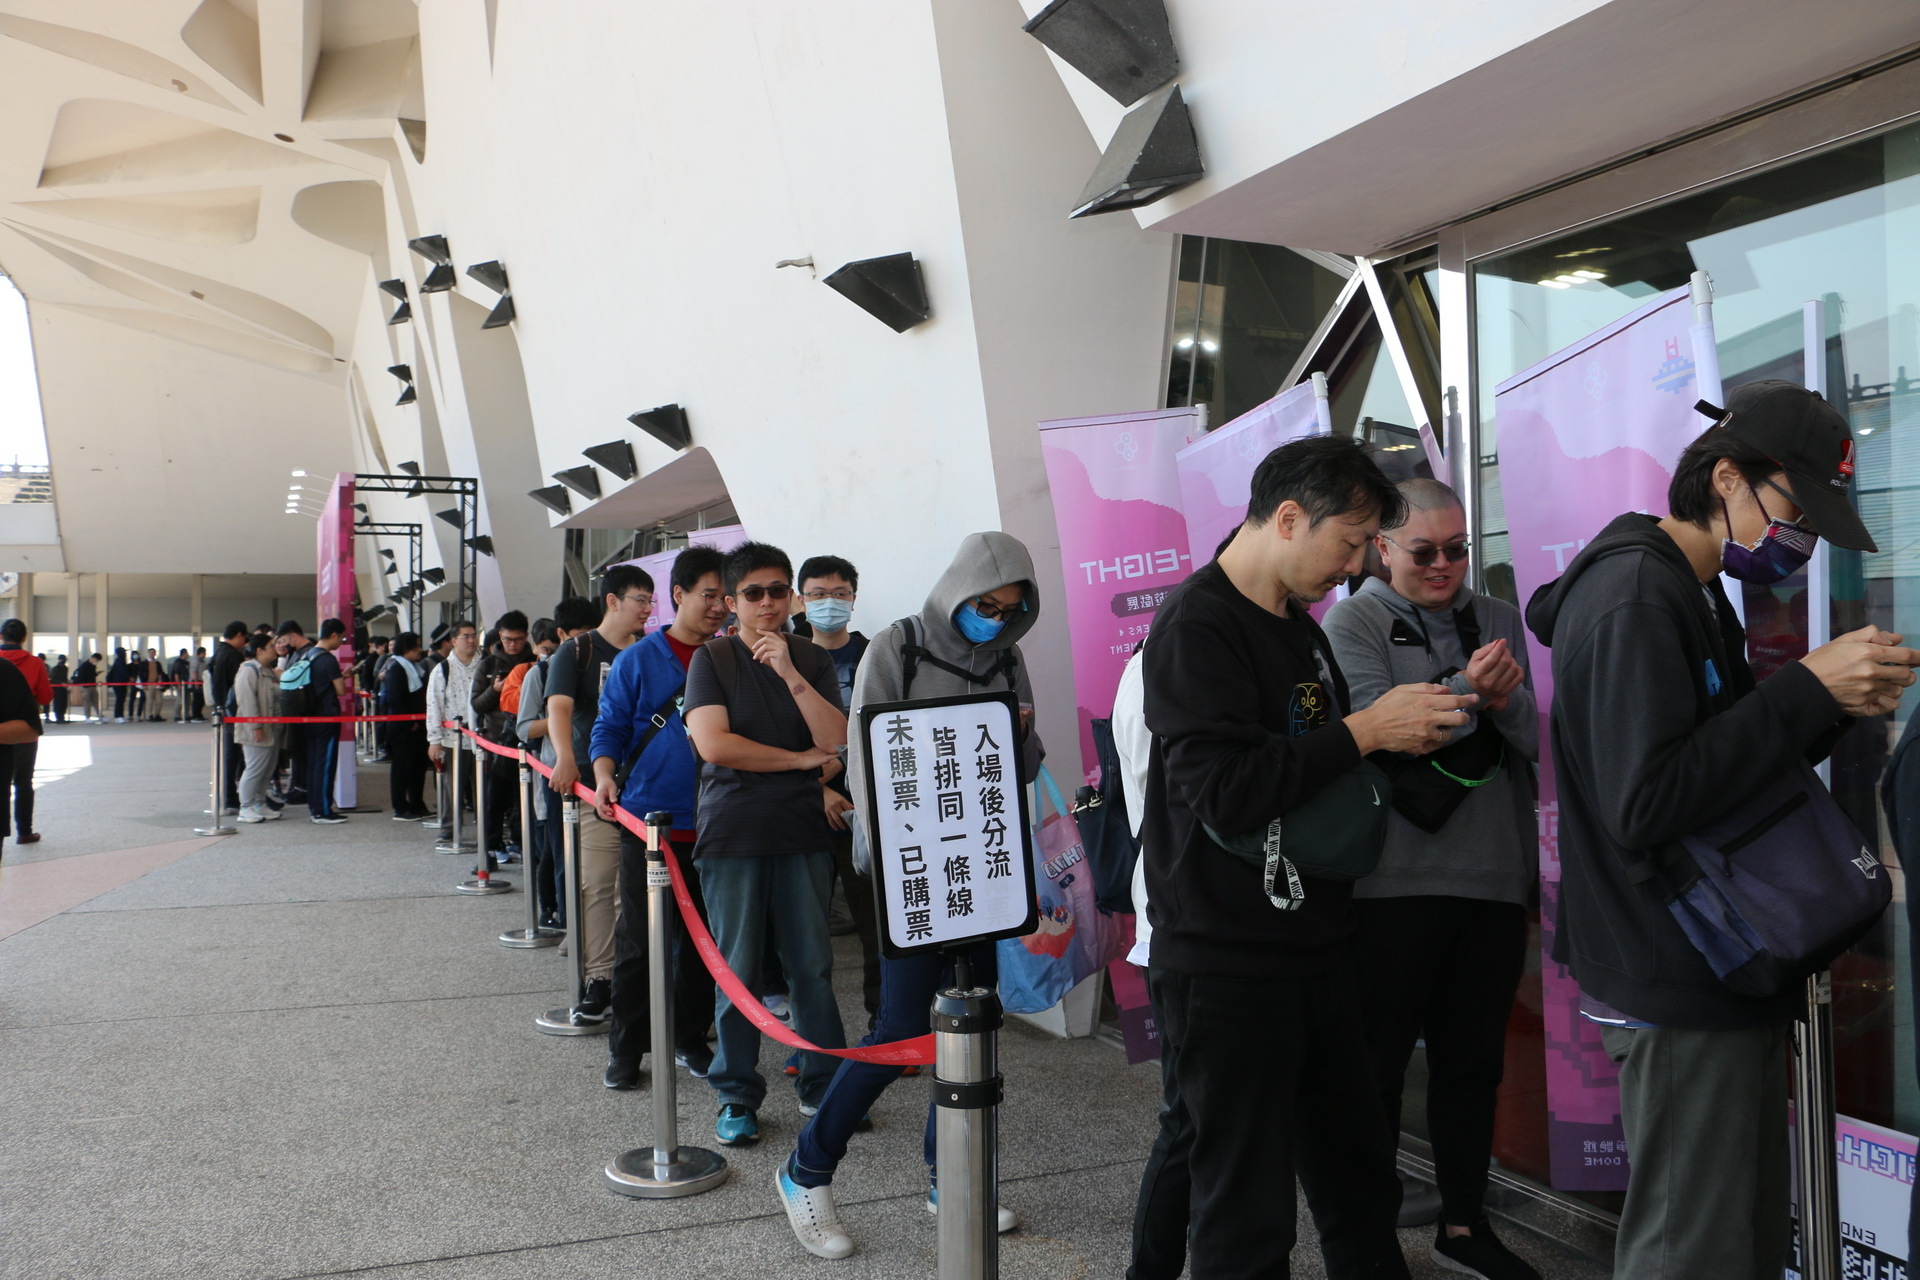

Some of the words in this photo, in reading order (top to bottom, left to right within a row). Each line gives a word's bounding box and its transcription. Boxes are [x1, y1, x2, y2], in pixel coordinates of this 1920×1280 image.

[886, 714, 934, 942] 未購票、已購票
[932, 726, 975, 919] 皆排同一條線
[974, 723, 1012, 880] 入場後分流
